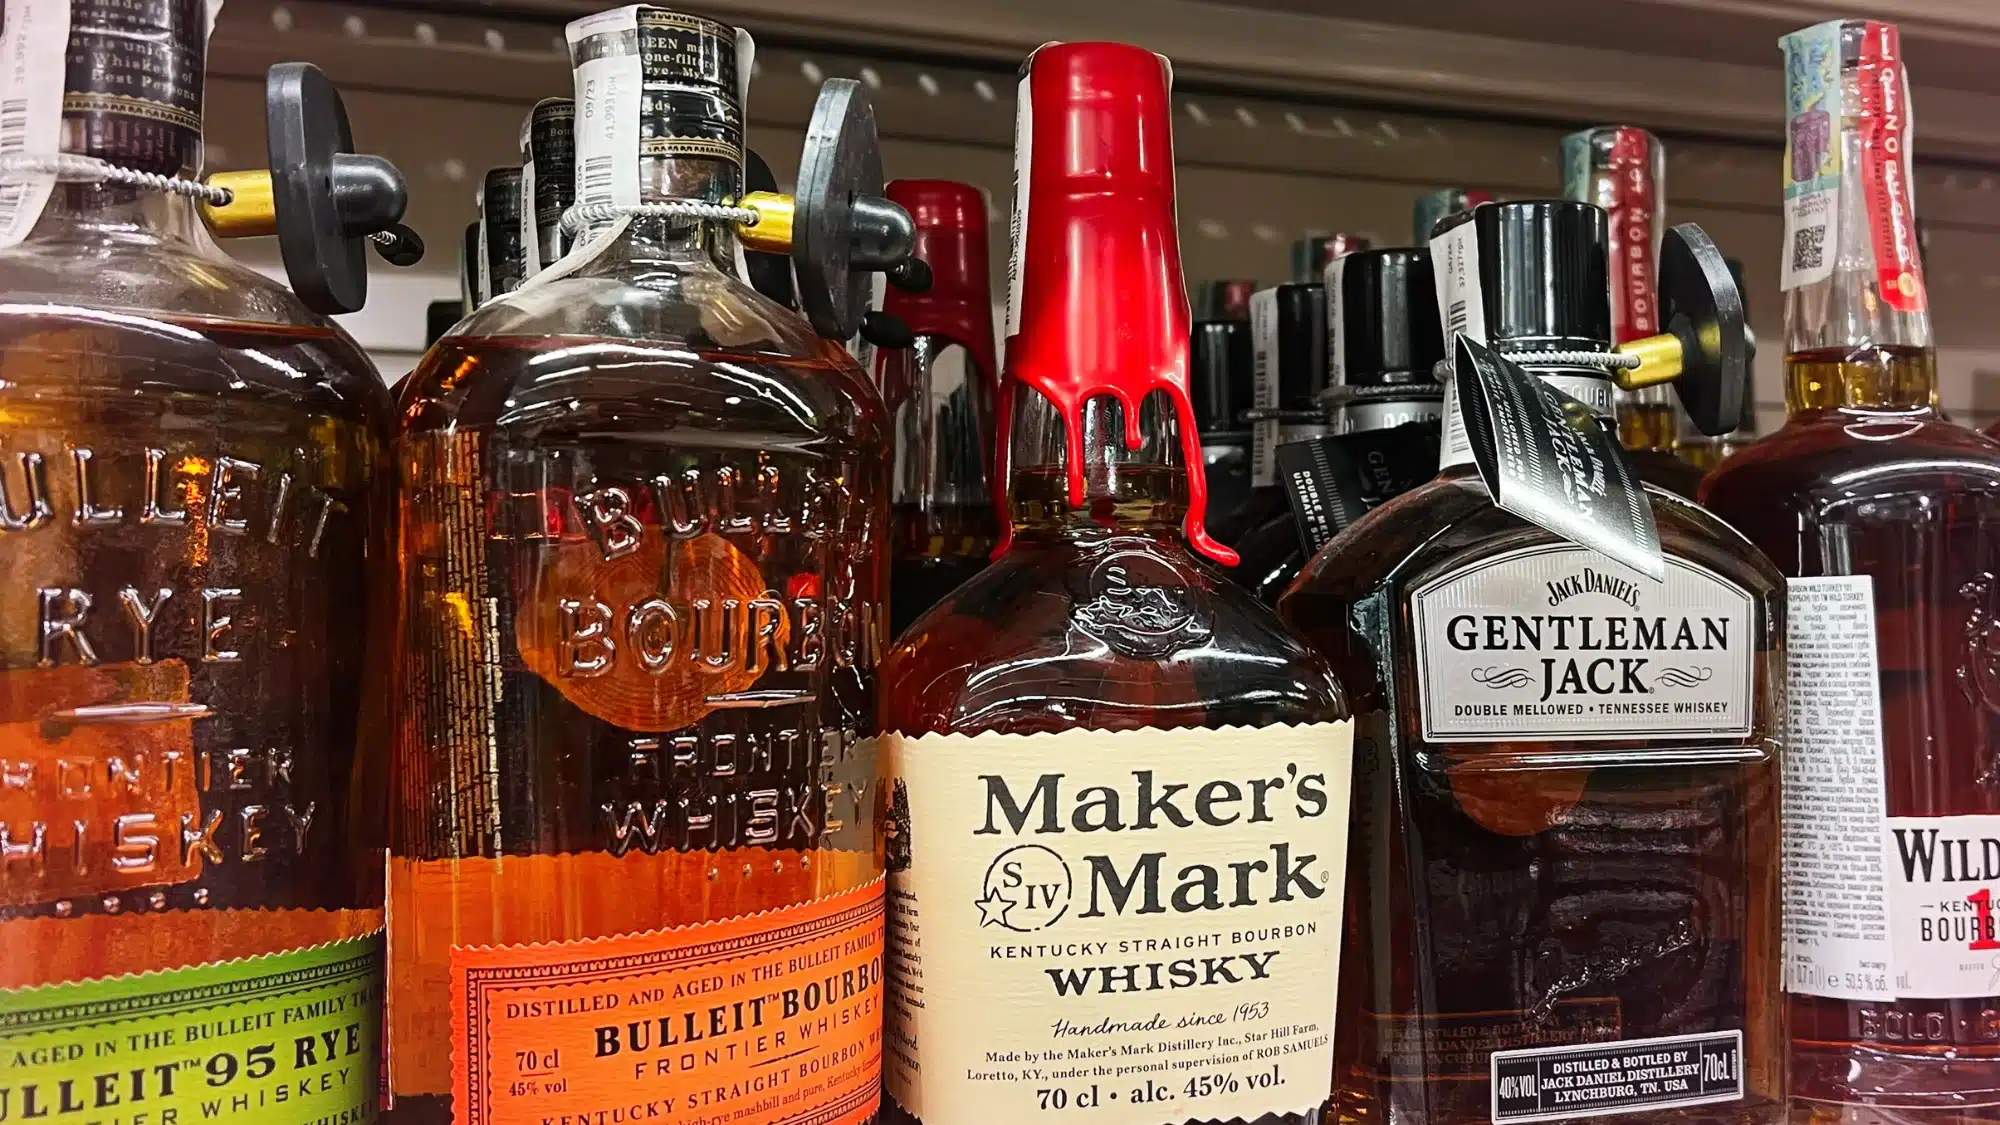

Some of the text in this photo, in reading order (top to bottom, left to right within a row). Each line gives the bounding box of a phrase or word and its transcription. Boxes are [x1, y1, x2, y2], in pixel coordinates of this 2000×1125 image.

[92, 68, 133, 85] Best
[585, 79, 596, 119] 09/23
[1629, 206, 1650, 331] BOURBON
[1502, 399, 1523, 456] MELLOWED
[1540, 413, 1572, 474] JACK
[1367, 450, 1397, 494] GEN
[0, 447, 333, 558] ULLEIT
[1293, 471, 1323, 551] ULTIMATE SMO
[1302, 470, 1331, 544] DOUBLE MELL
[1548, 574, 1585, 608] JACK
[37, 585, 242, 667] RYE
[559, 597, 884, 677] BOURBON
[1446, 614, 1730, 651] GENTLEMAN
[1454, 701, 1729, 717] DOUBLE MELLOWED TENNESSEE WHISKEY
[600, 779, 868, 857] WHISKEY
[972, 761, 1328, 836] Maker's
[0, 801, 316, 878] HISKEY
[1892, 828, 2000, 883] WILD
[1002, 861, 1024, 889] S
[1025, 882, 1063, 910] IV
[1920, 916, 1996, 943] BOURB
[1940, 900, 2000, 913] KENTUC
[1966, 888, 2000, 951] 1
[990, 920, 1317, 960] KENTUCKY STRAIGHT BOURBON
[506, 993, 620, 1020] DISTILLED
[627, 987, 665, 1007] AND
[672, 975, 724, 999] AGED
[731, 971, 746, 987] IN
[752, 961, 784, 983] THE
[788, 945, 841, 974] BULLEIT
[844, 933, 876, 957] FAMILY
[1044, 949, 1281, 999] WHISKY
[10, 1043, 84, 1069] AGED
[95, 1039, 117, 1058] IN
[127, 1028, 176, 1052] THE
[184, 1011, 276, 1043] BULLEIT
[282, 992, 347, 1025] FAMILY
[634, 993, 880, 1081] FRONTIER WHISKEY
[985, 1021, 1320, 1064] Made by the Maker's Mark Distillery Inc., Star Hill Farm,
[1051, 1000, 1271, 1039] Handmade since 1953
[1858, 1008, 1945, 1040] BOLD
[205, 1042, 277, 1088] 95
[293, 1022, 361, 1070] RYE
[515, 1049, 560, 1073] 70 cl
[966, 1033, 1329, 1083] Loretto, KY., under the personal supervision of ROB SAMUELS
[1540, 1063, 1701, 1091] JACK DANIEL DISTILLERY
[1553, 1051, 1688, 1075] DISTILLED & BOTTLED BY
[200, 1067, 351, 1120] WHISKEY
[508, 1079, 568, 1098] 45% vol
[540, 1097, 677, 1125] KENTUCKY
[687, 1068, 791, 1110] STRAIGHT
[799, 1039, 865, 1078] BOURBON
[733, 1096, 780, 1121] mashbill
[782, 1087, 801, 1106] and
[802, 1083, 826, 1105] pure,
[827, 1063, 862, 1091] Kentucky
[1035, 1063, 1287, 1111] 70 cl alc. 45% vol.
[1554, 1078, 1689, 1103] LYNCHBURG, TN. USA
